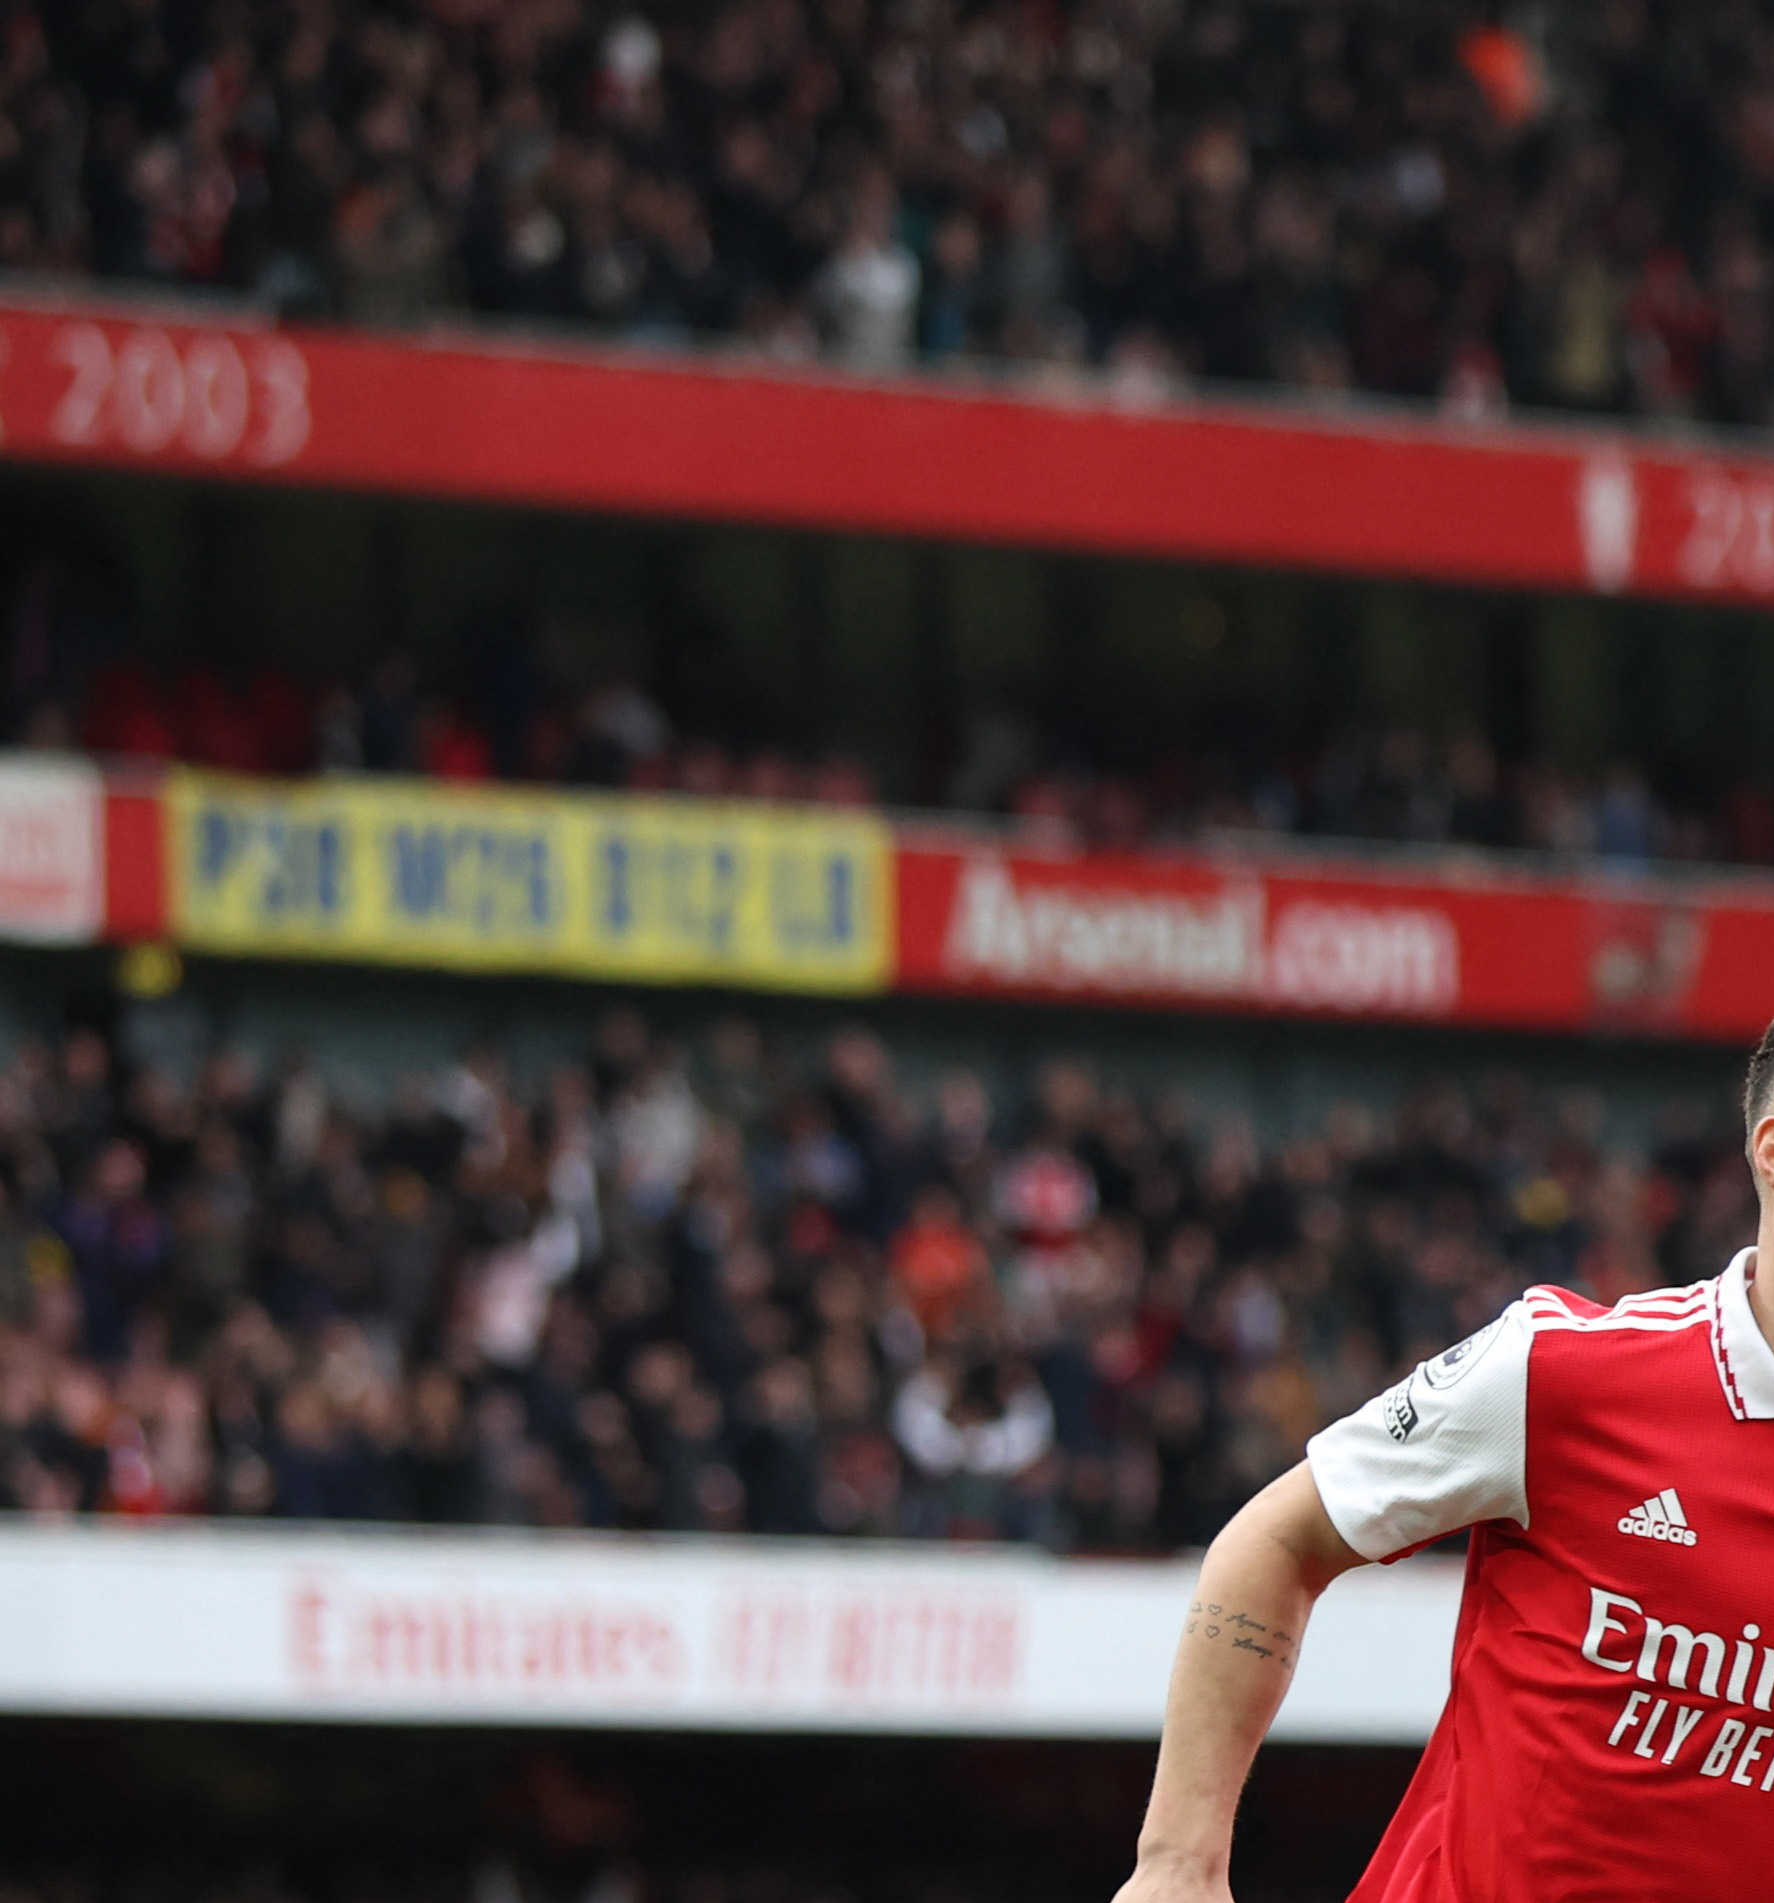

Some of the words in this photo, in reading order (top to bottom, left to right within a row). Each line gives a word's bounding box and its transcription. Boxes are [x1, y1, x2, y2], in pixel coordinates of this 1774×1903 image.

[51, 320, 311, 467] 2003
[1618, 1516, 1697, 1547] adidas
[284, 1567, 689, 1698] Emirates
[1607, 1690, 1703, 1765] FLY
